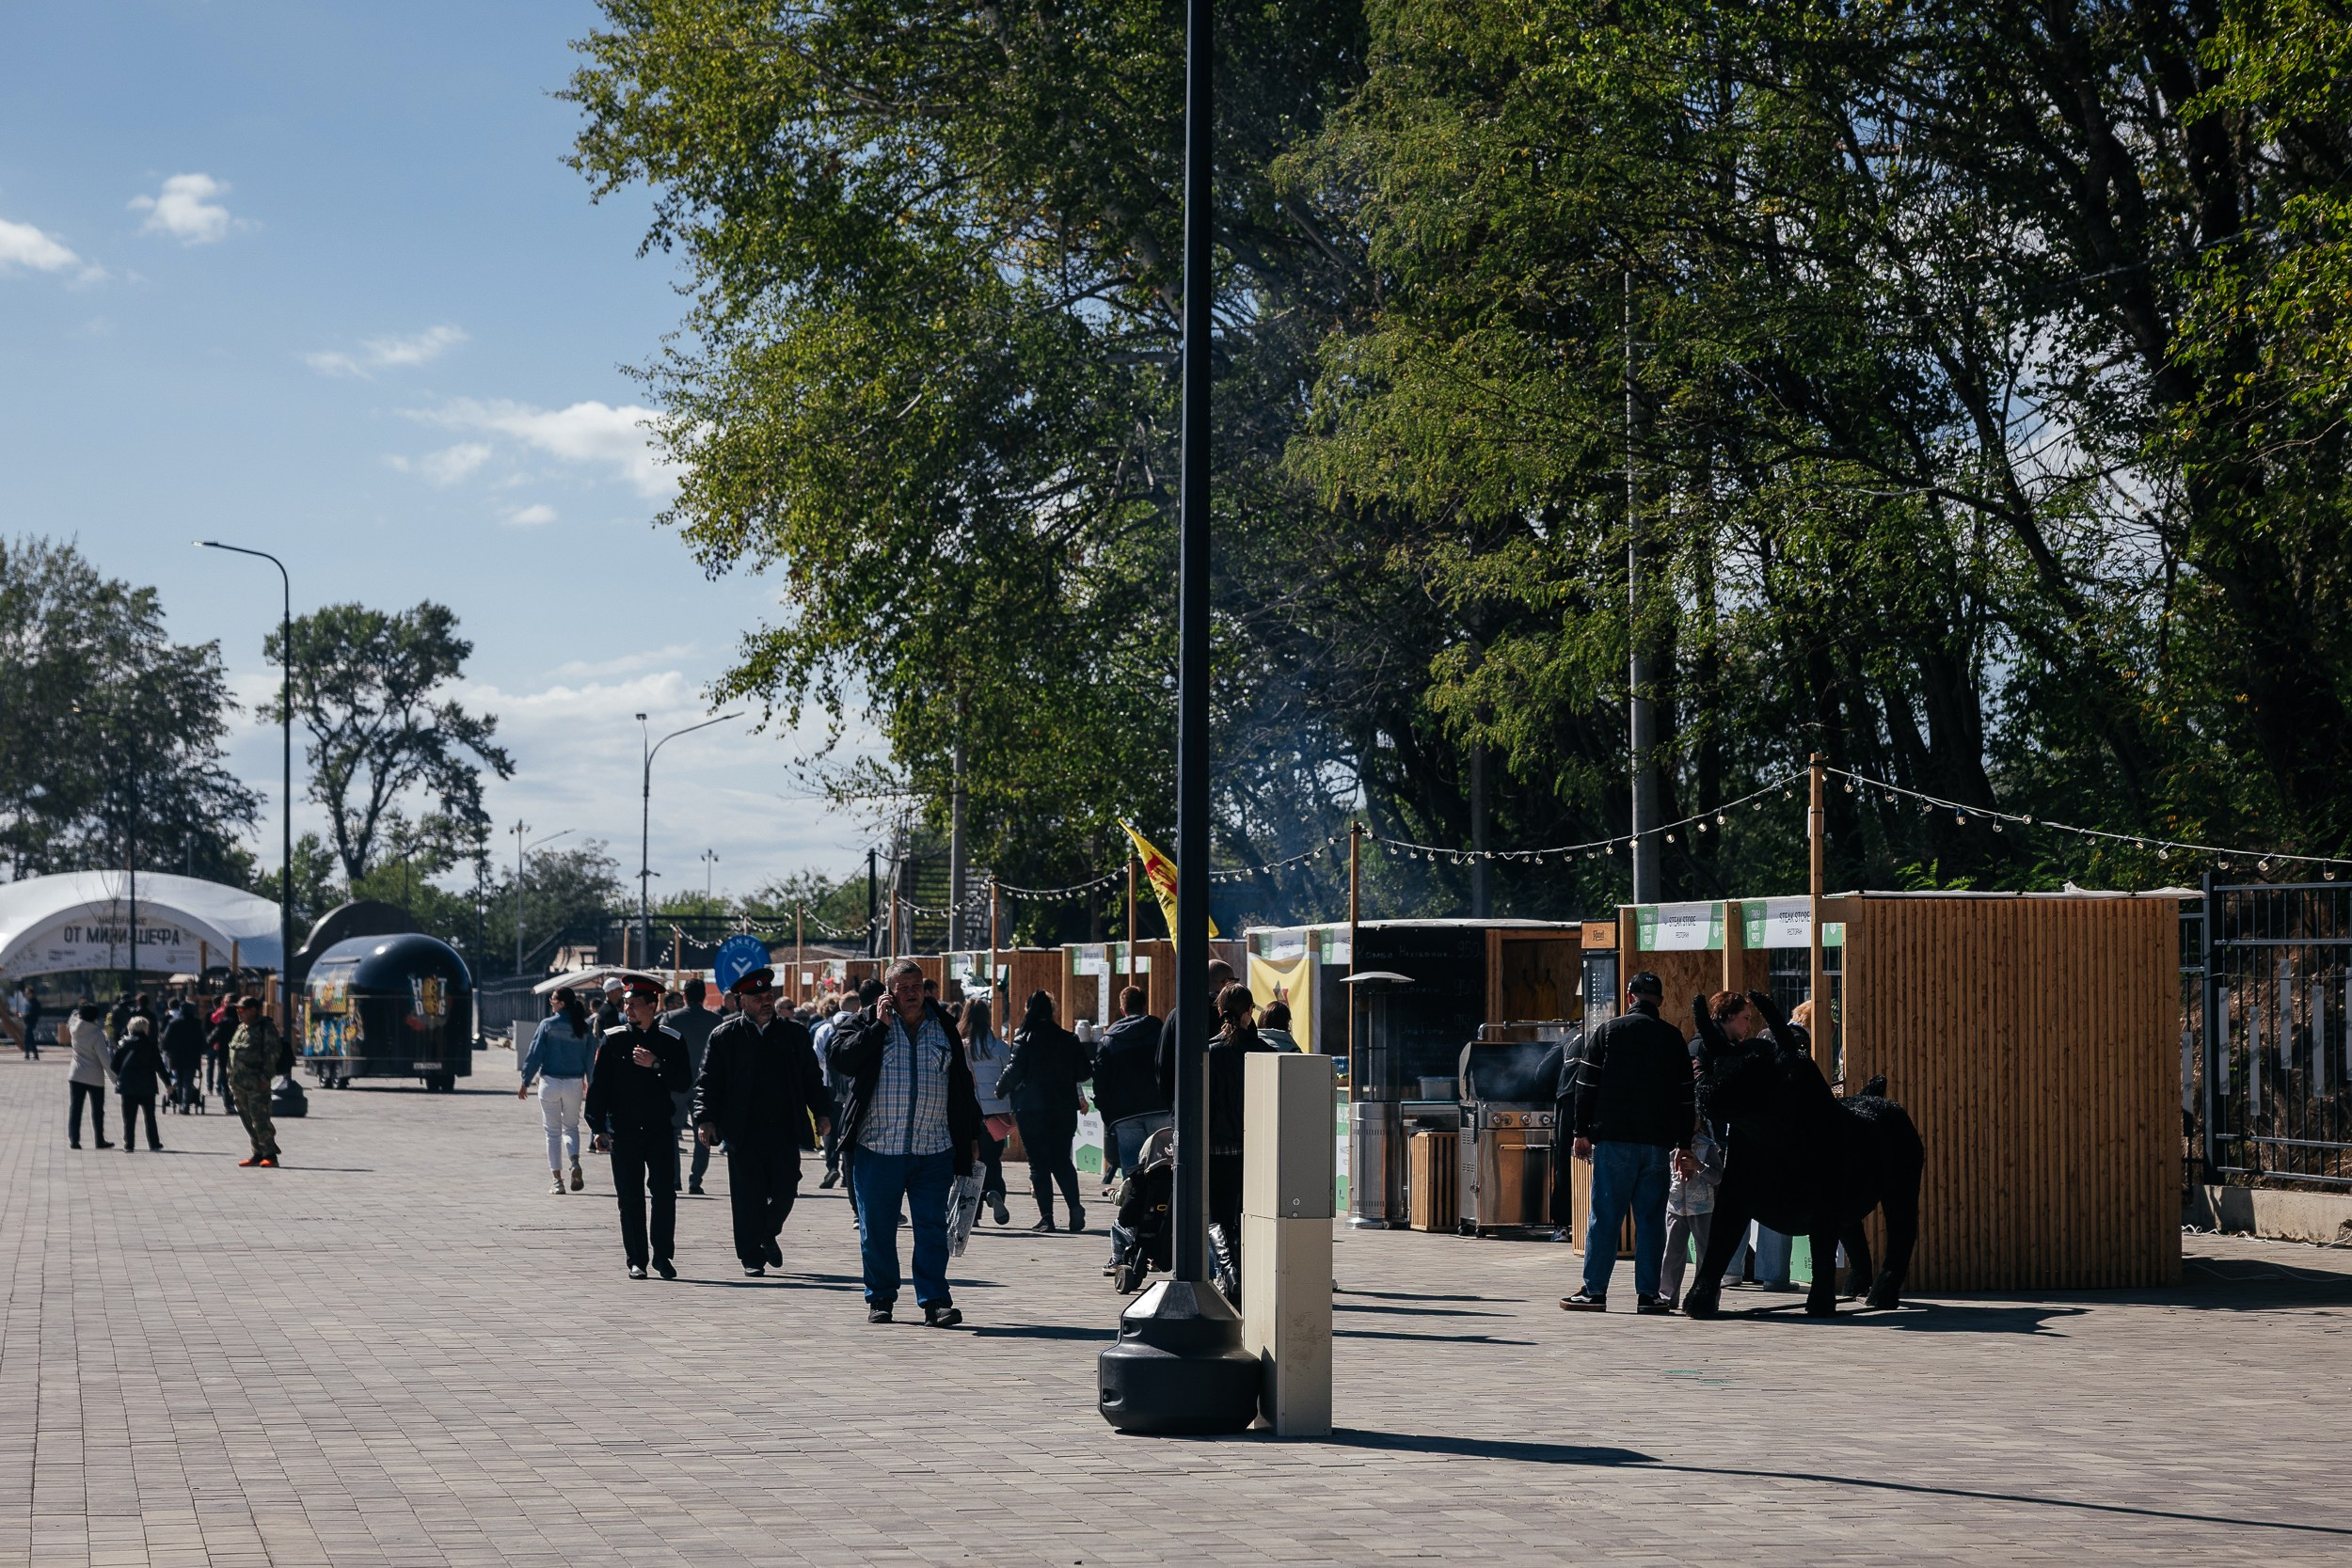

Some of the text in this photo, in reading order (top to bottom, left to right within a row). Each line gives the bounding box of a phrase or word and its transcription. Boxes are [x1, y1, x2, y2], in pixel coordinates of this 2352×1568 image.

[1669, 916, 1696, 927] STEAK STORE
[1779, 911, 1810, 923] STEAK STORE
[64, 926, 82, 943] ОТ
